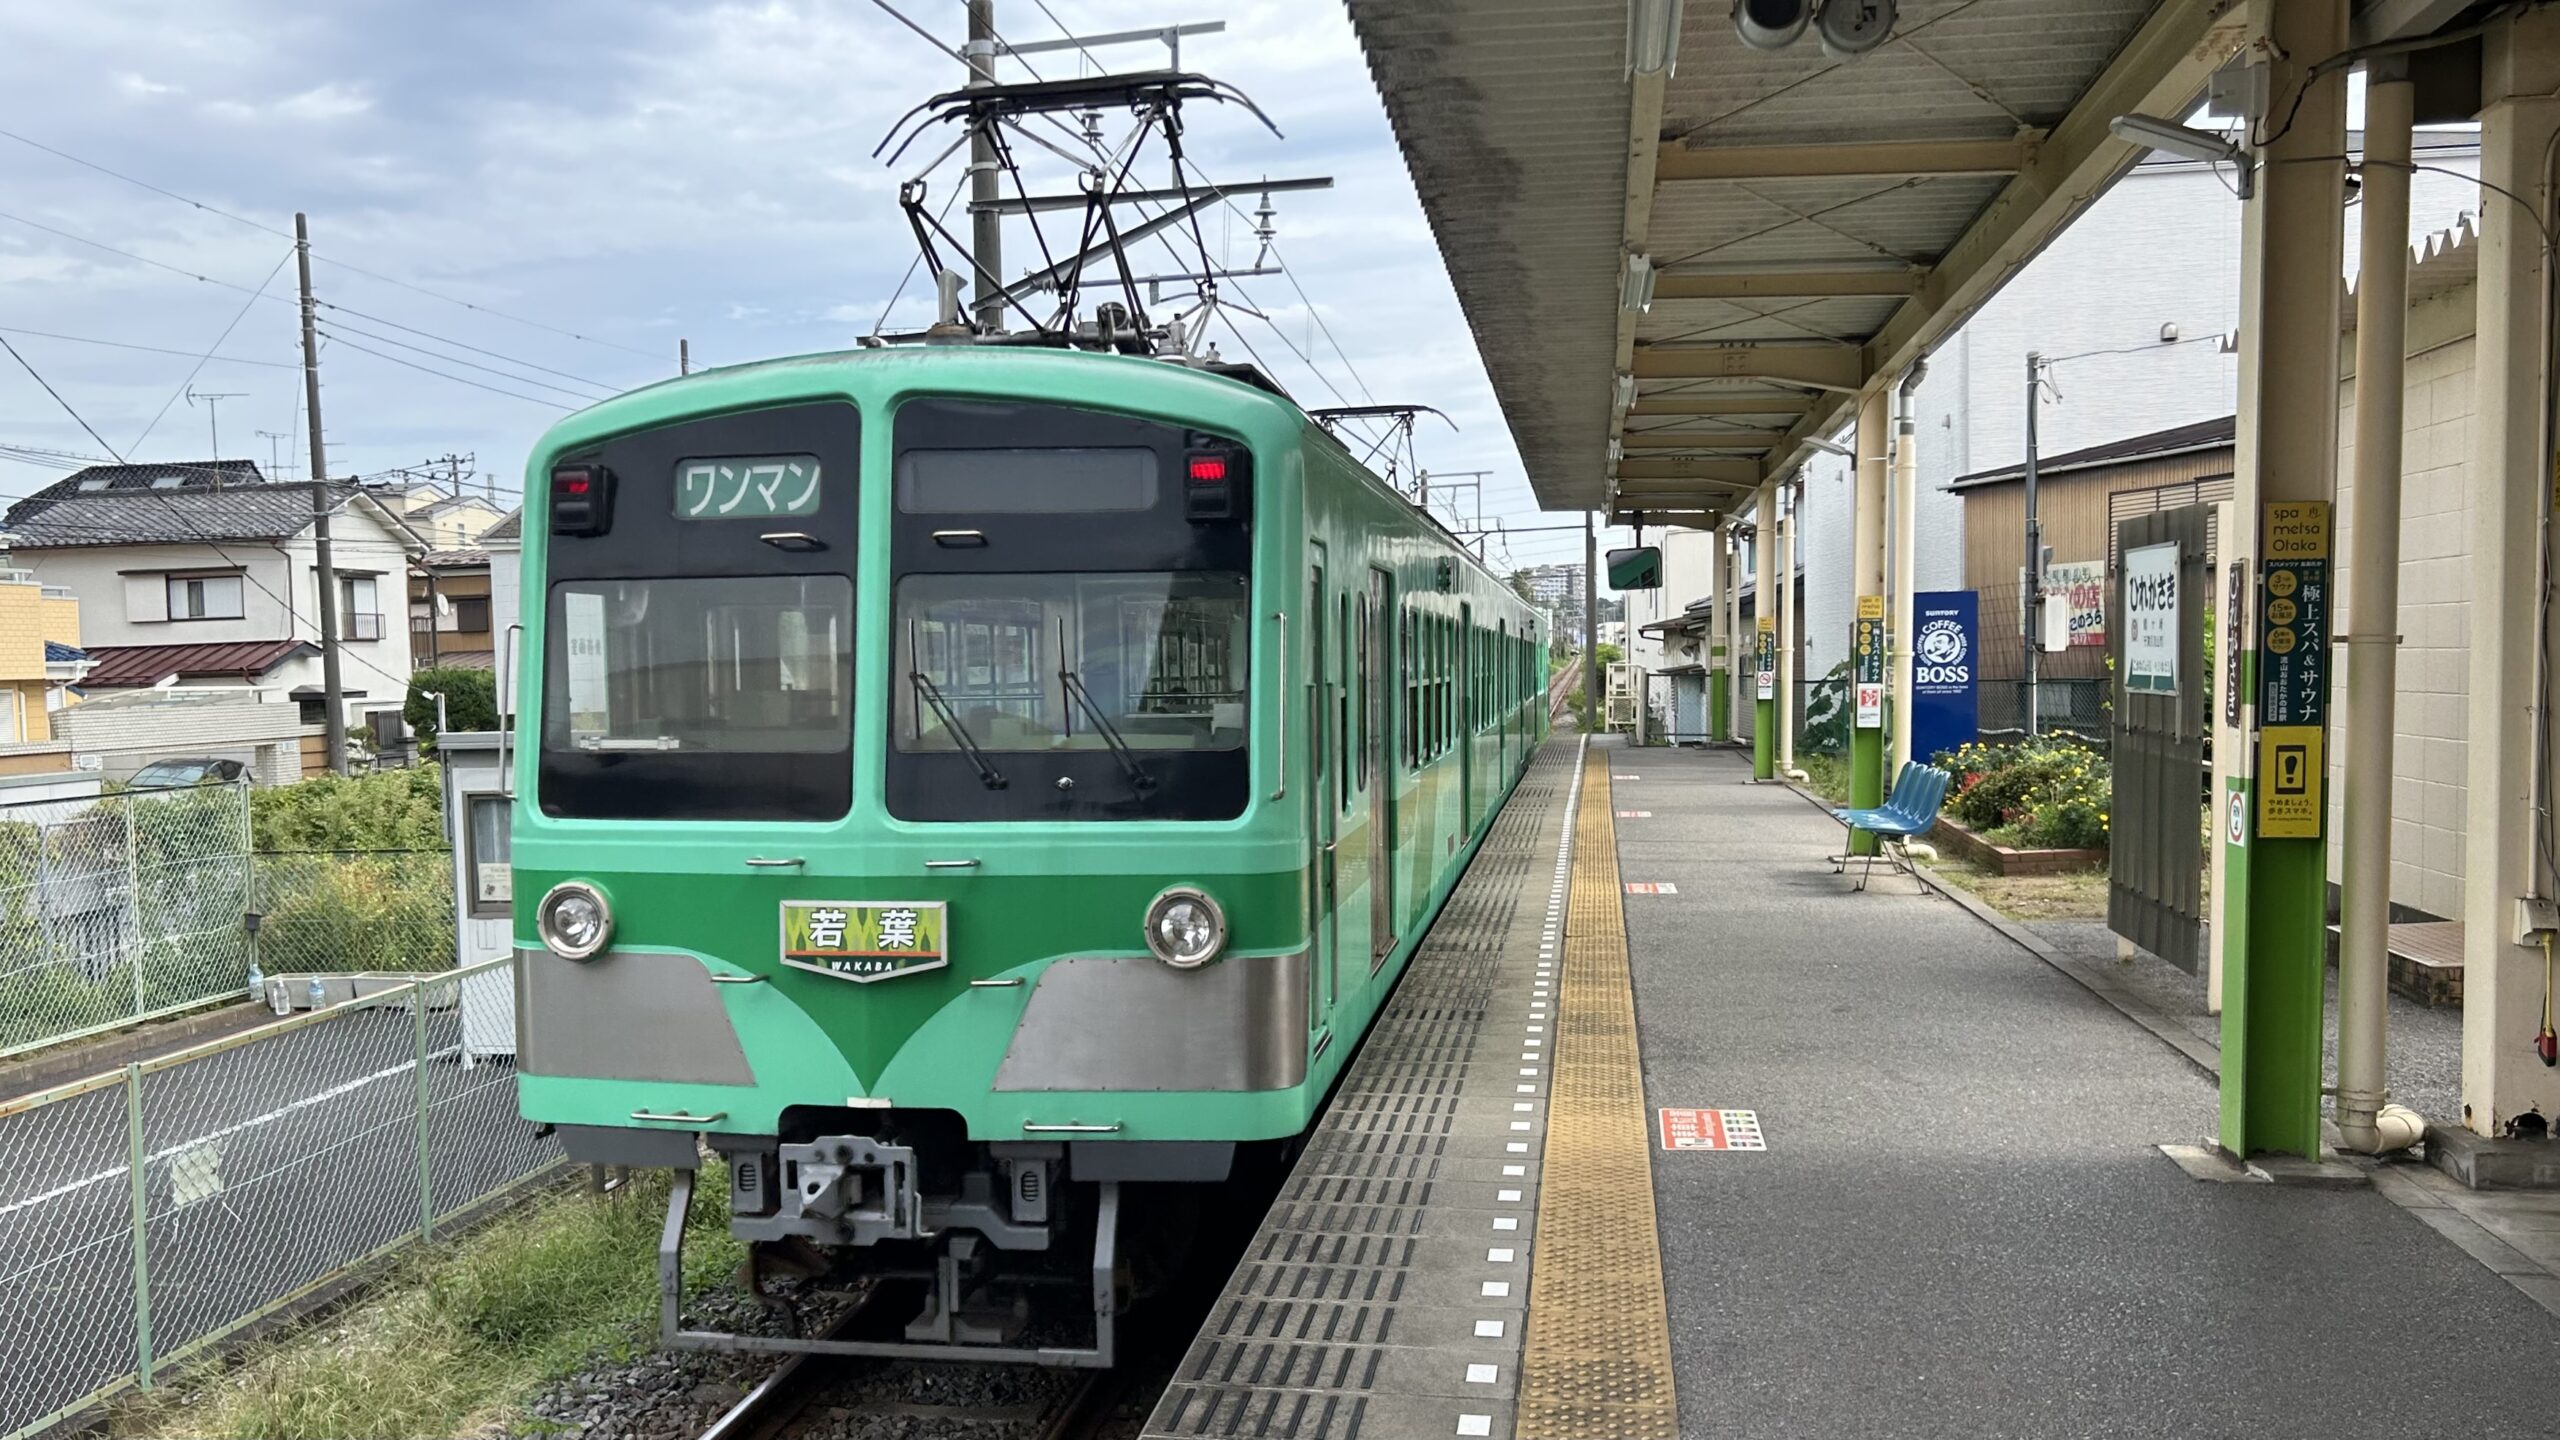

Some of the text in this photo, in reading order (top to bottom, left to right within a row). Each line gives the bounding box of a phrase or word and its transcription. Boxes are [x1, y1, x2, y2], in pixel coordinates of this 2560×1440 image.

[686, 462, 821, 516] ワンマン
[2273, 509, 2299, 521] spa
[2273, 522, 2320, 535] metsa
[2272, 539, 2317, 552] Otaka
[2130, 571, 2175, 612] ひれがさき
[2272, 583, 2292, 591] サウナ
[1922, 619, 1963, 634] COFFEE
[2227, 571, 2240, 717] ひれがさき
[2299, 584, 2320, 722] 極上スパ&サウナ
[1916, 666, 1969, 683] BOSS
[2268, 807, 2312, 815] 歩きスマホ。
[808, 908, 918, 949] 若葉
[831, 960, 894, 973] WAKABA
